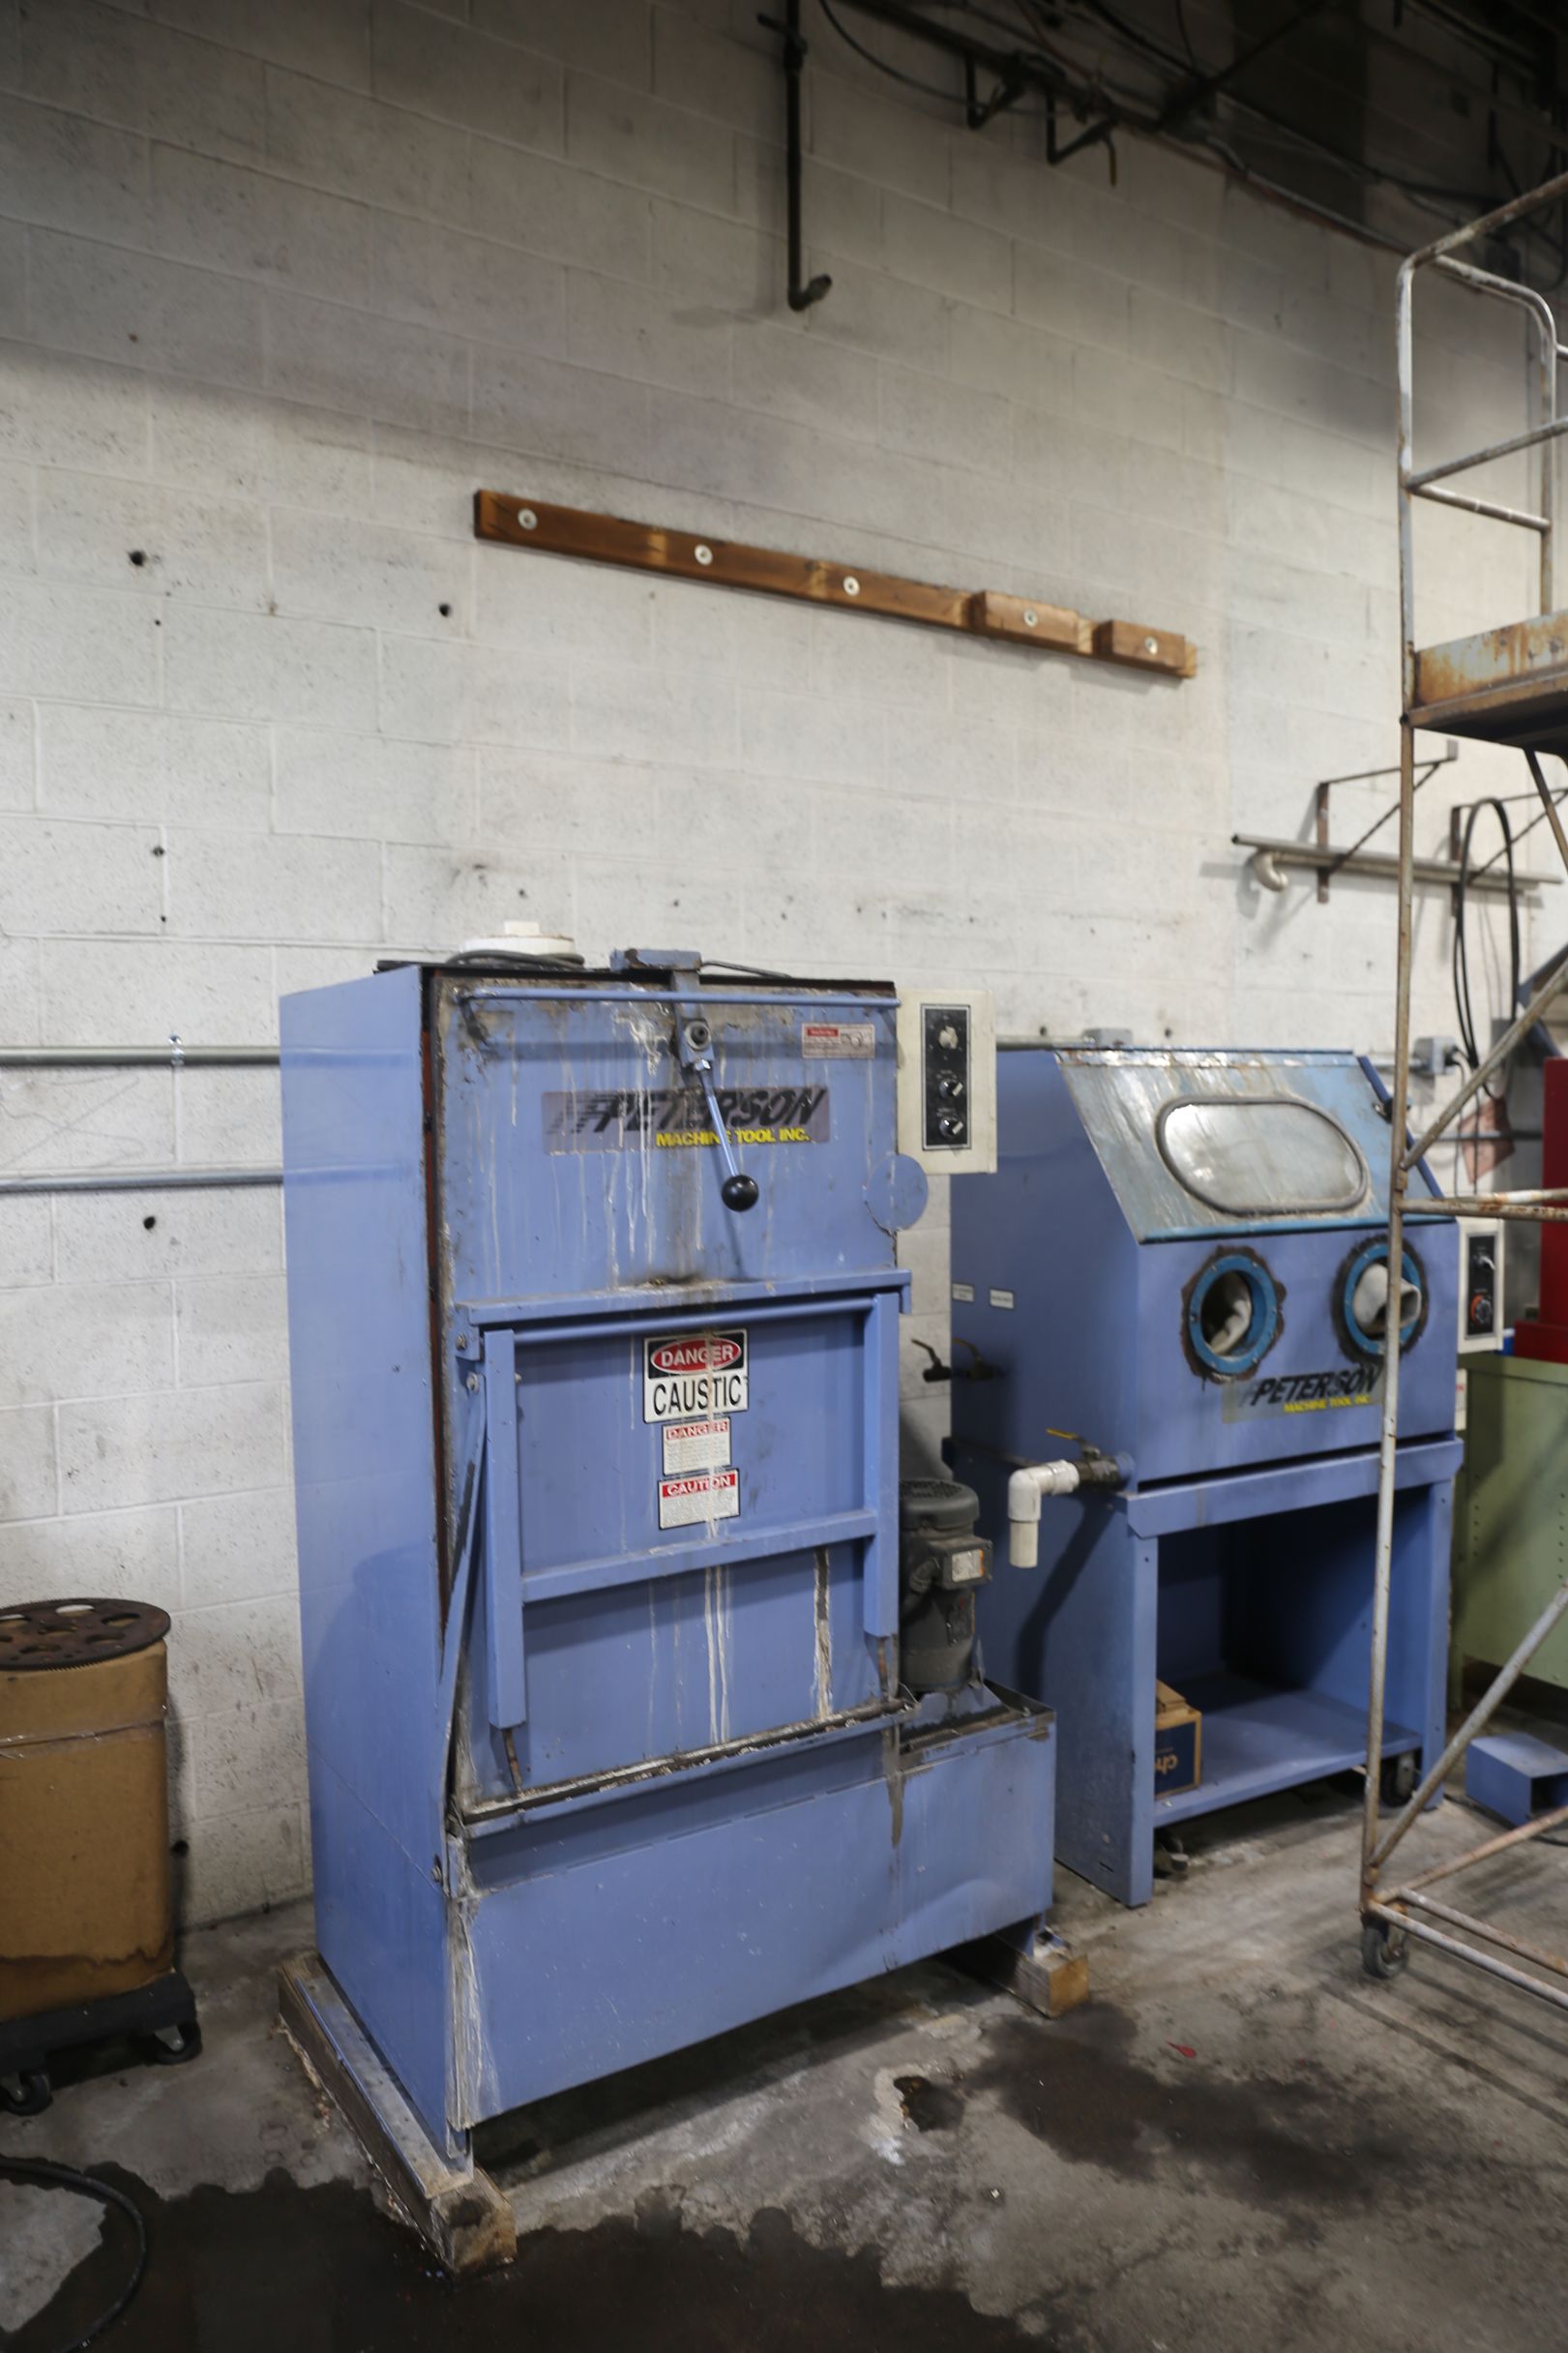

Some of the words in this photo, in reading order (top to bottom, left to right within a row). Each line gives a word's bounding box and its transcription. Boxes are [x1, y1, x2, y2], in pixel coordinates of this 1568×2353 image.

[736, 1129, 775, 1144] TOOL
[779, 1127, 810, 1142] INC.
[661, 1344, 734, 1367] DANGER
[653, 1375, 741, 1415] CAUSTIC
[1248, 1362, 1383, 1406] PETERSON
[666, 1421, 728, 1440] DANGER
[666, 1474, 731, 1497] CAUTION
